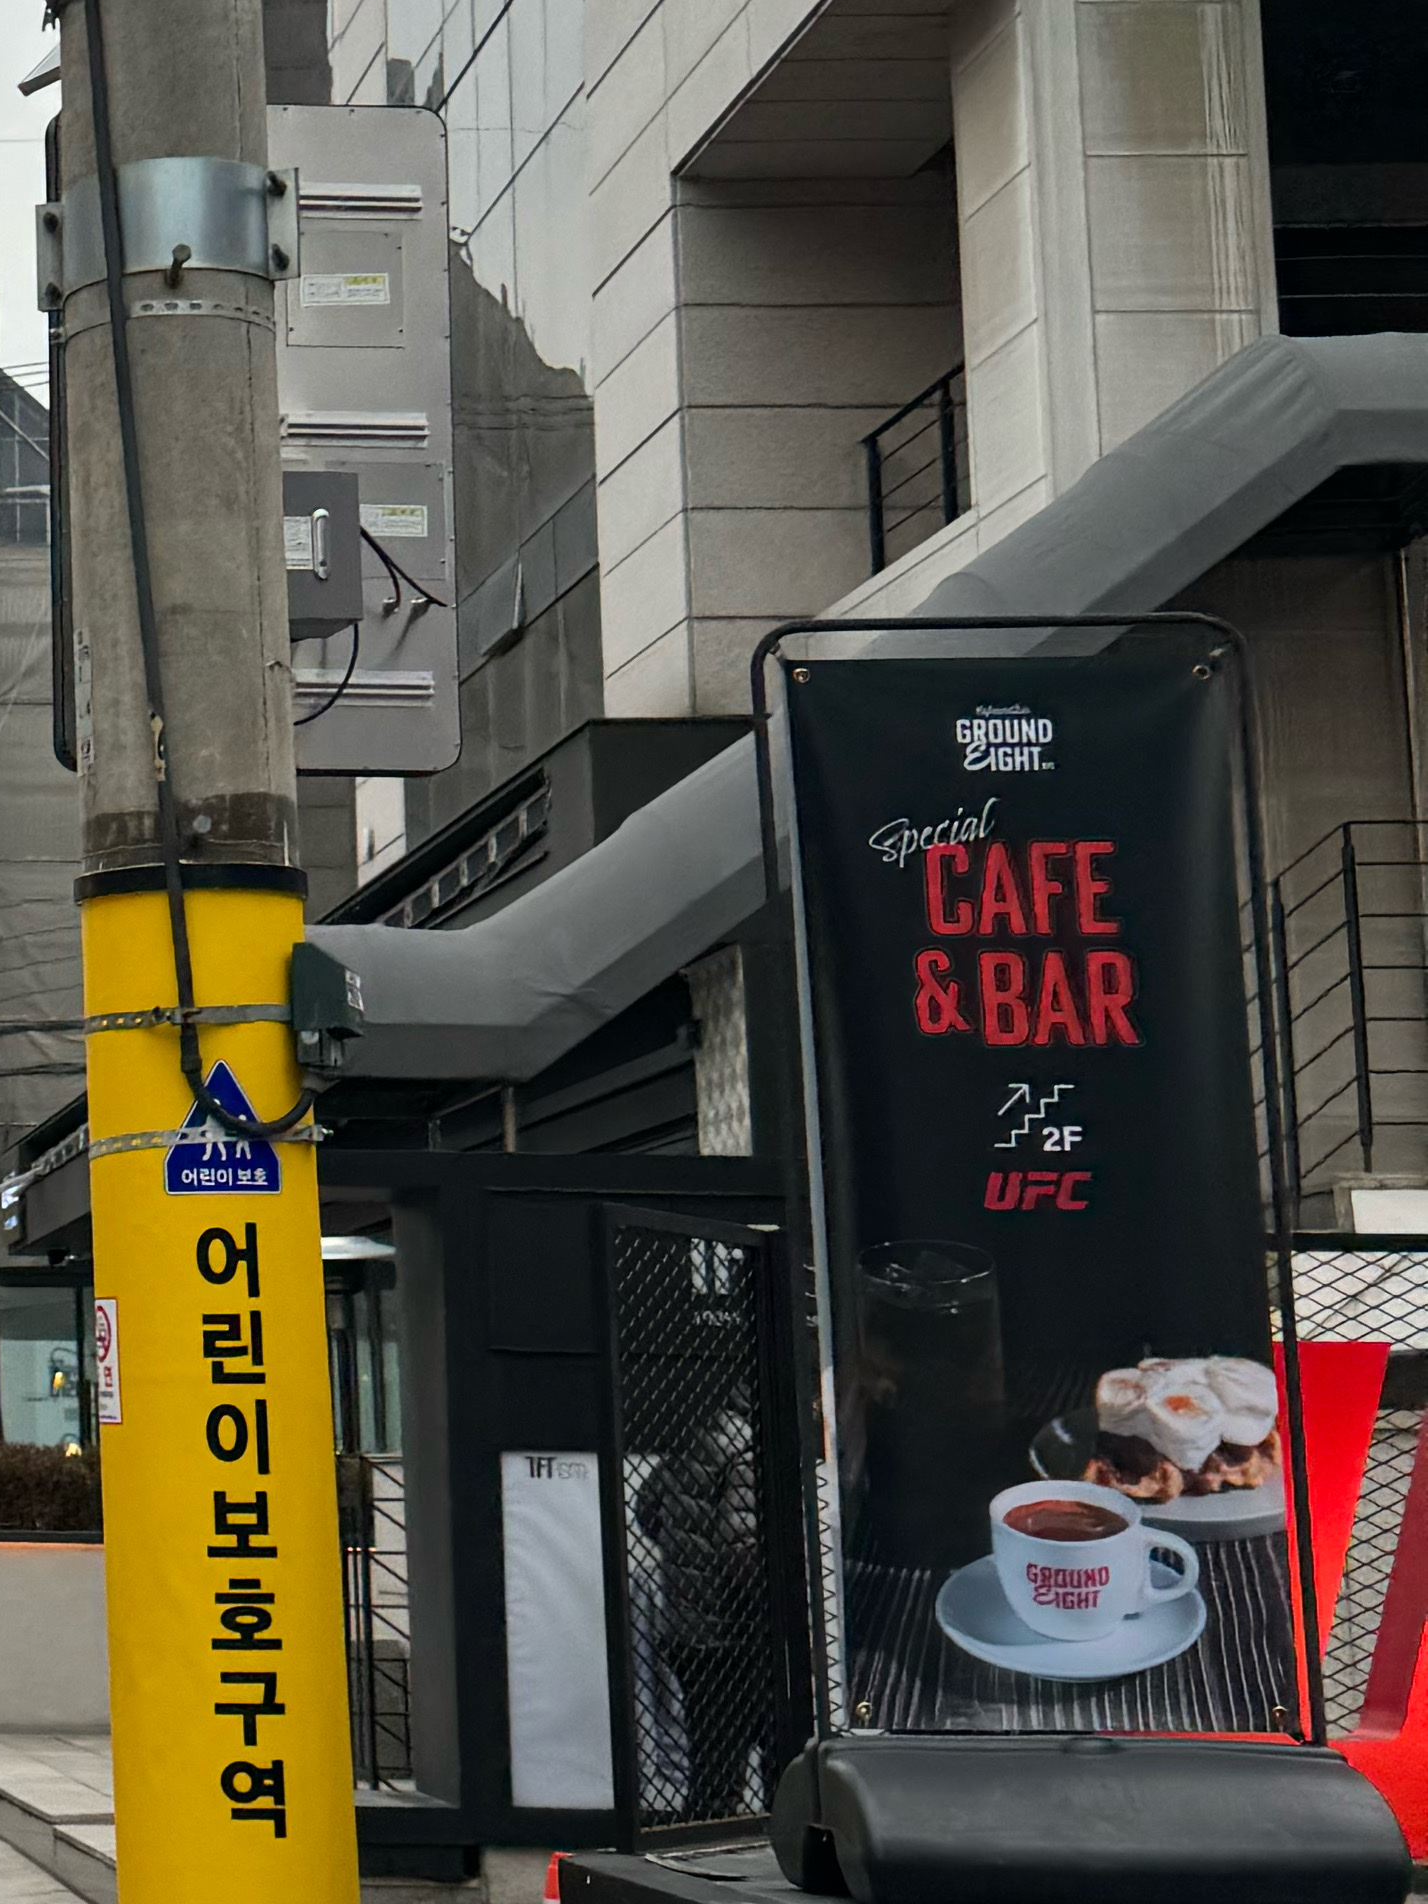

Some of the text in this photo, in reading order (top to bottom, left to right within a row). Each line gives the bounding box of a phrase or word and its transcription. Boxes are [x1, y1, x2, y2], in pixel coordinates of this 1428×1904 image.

[956, 718, 1053, 744] GROUND
[963, 741, 1042, 772] EIGHT
[868, 797, 1000, 869] Special
[925, 840, 1122, 936] CAFE
[914, 949, 1141, 1046] & BAR
[1041, 1125, 1084, 1152] 2F
[181, 1168, 269, 1187] 어린이 보호
[983, 1171, 1093, 1211] UFC
[195, 1221, 288, 1840] 어린이보호구역
[1026, 1562, 1110, 1589] GROUND
[1032, 1584, 1101, 1610] EIGHT
